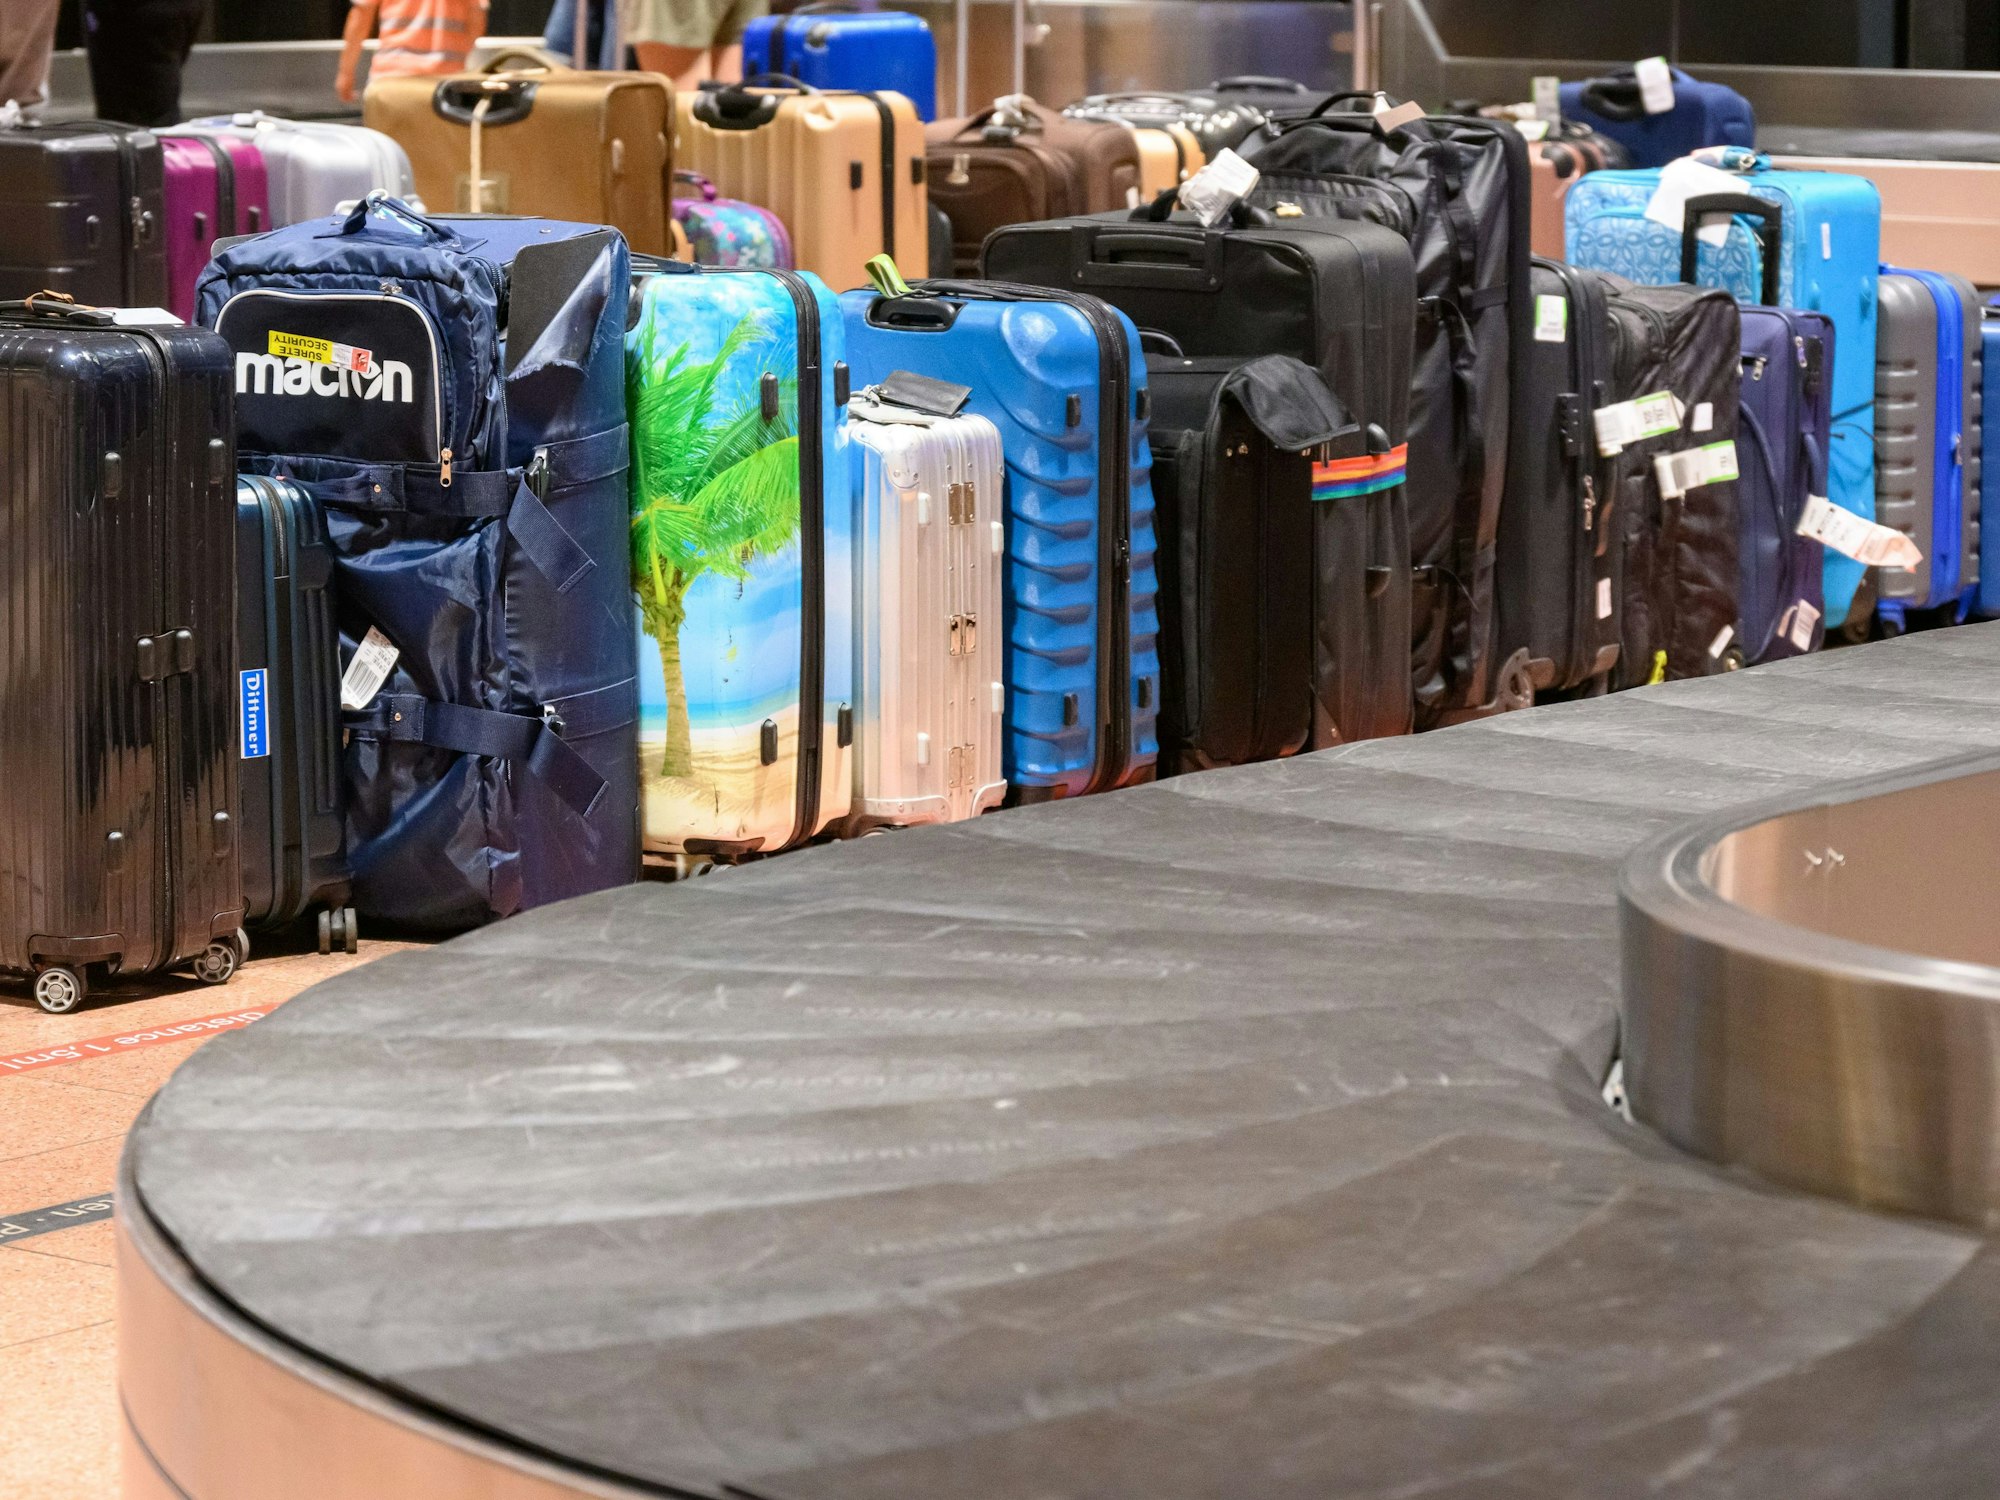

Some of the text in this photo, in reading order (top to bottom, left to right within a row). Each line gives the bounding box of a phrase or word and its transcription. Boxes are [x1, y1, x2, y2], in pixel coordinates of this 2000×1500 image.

[274, 334, 328, 351] SECURITY
[280, 346, 322, 361] SURETE
[246, 672, 261, 755] Dittmer
[114, 1011, 266, 1046] distance
